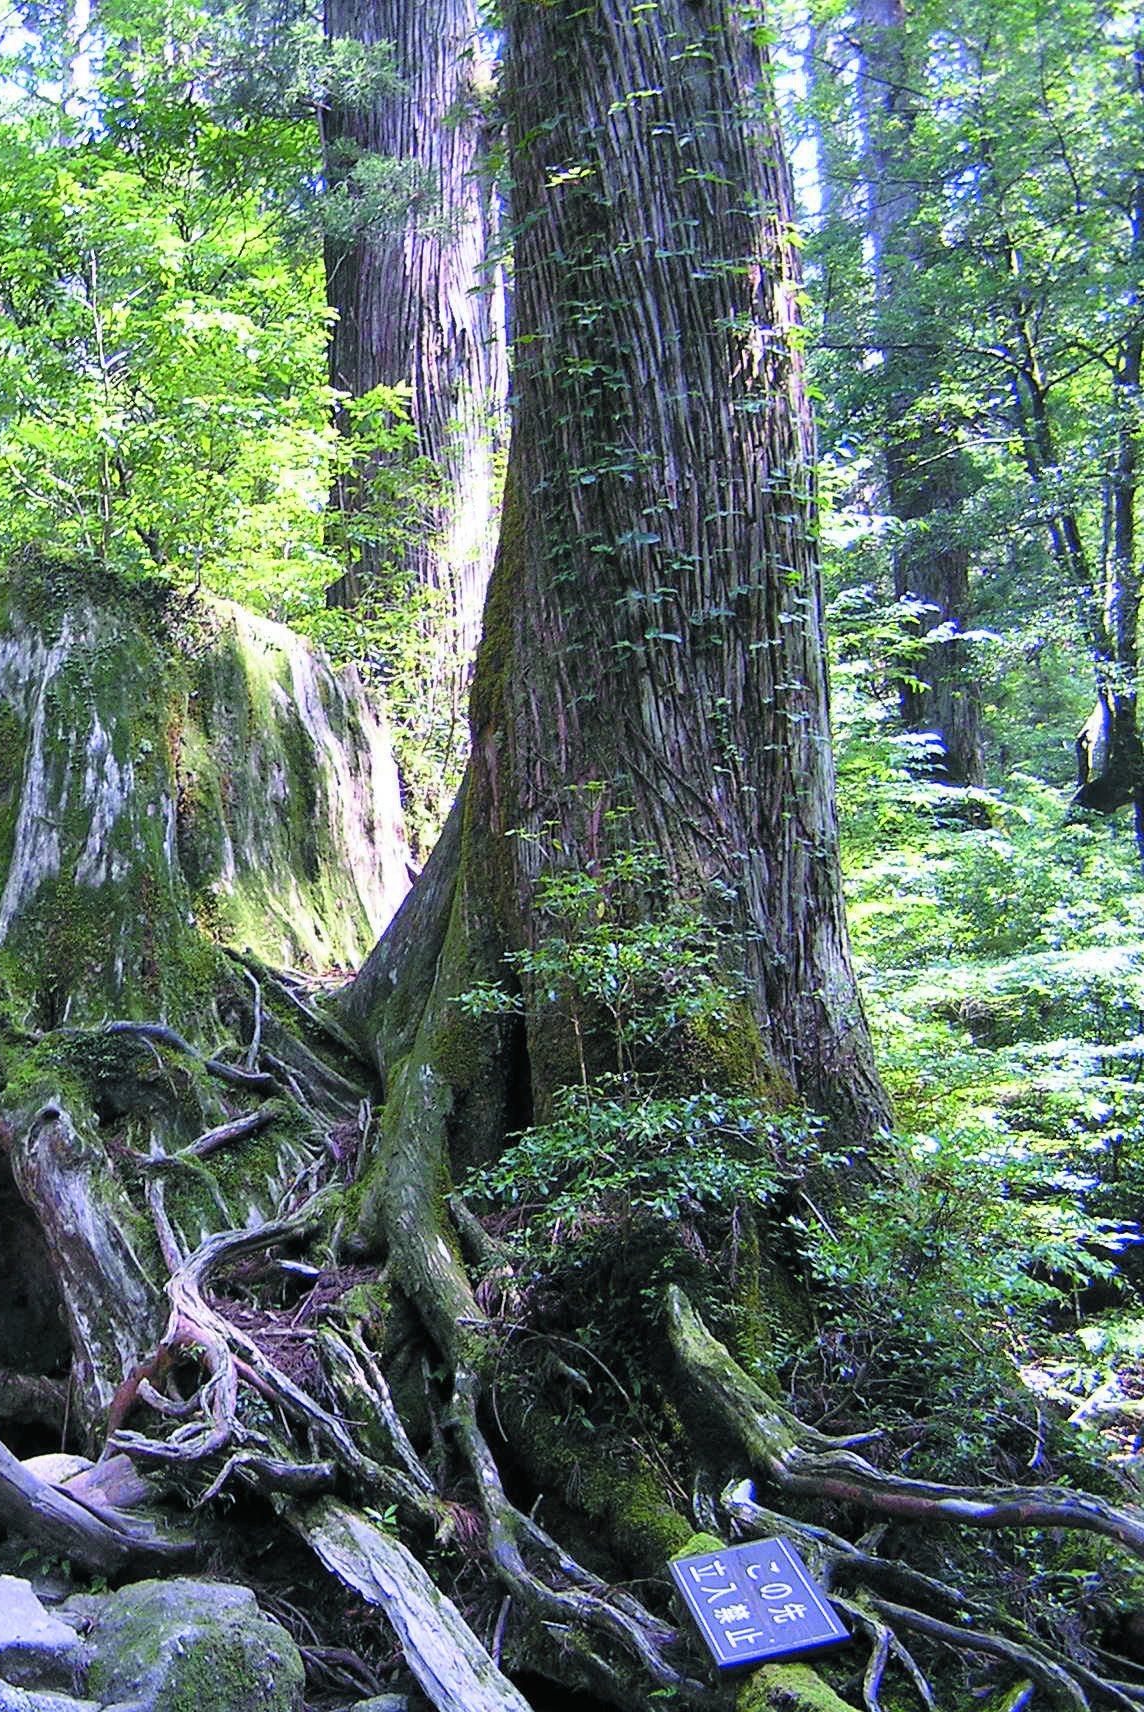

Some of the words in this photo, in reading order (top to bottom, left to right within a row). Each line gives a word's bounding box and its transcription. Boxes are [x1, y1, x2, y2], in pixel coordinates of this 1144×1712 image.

[689, 1560, 763, 1648] 立入禁止
[746, 1561, 807, 1623] この先
